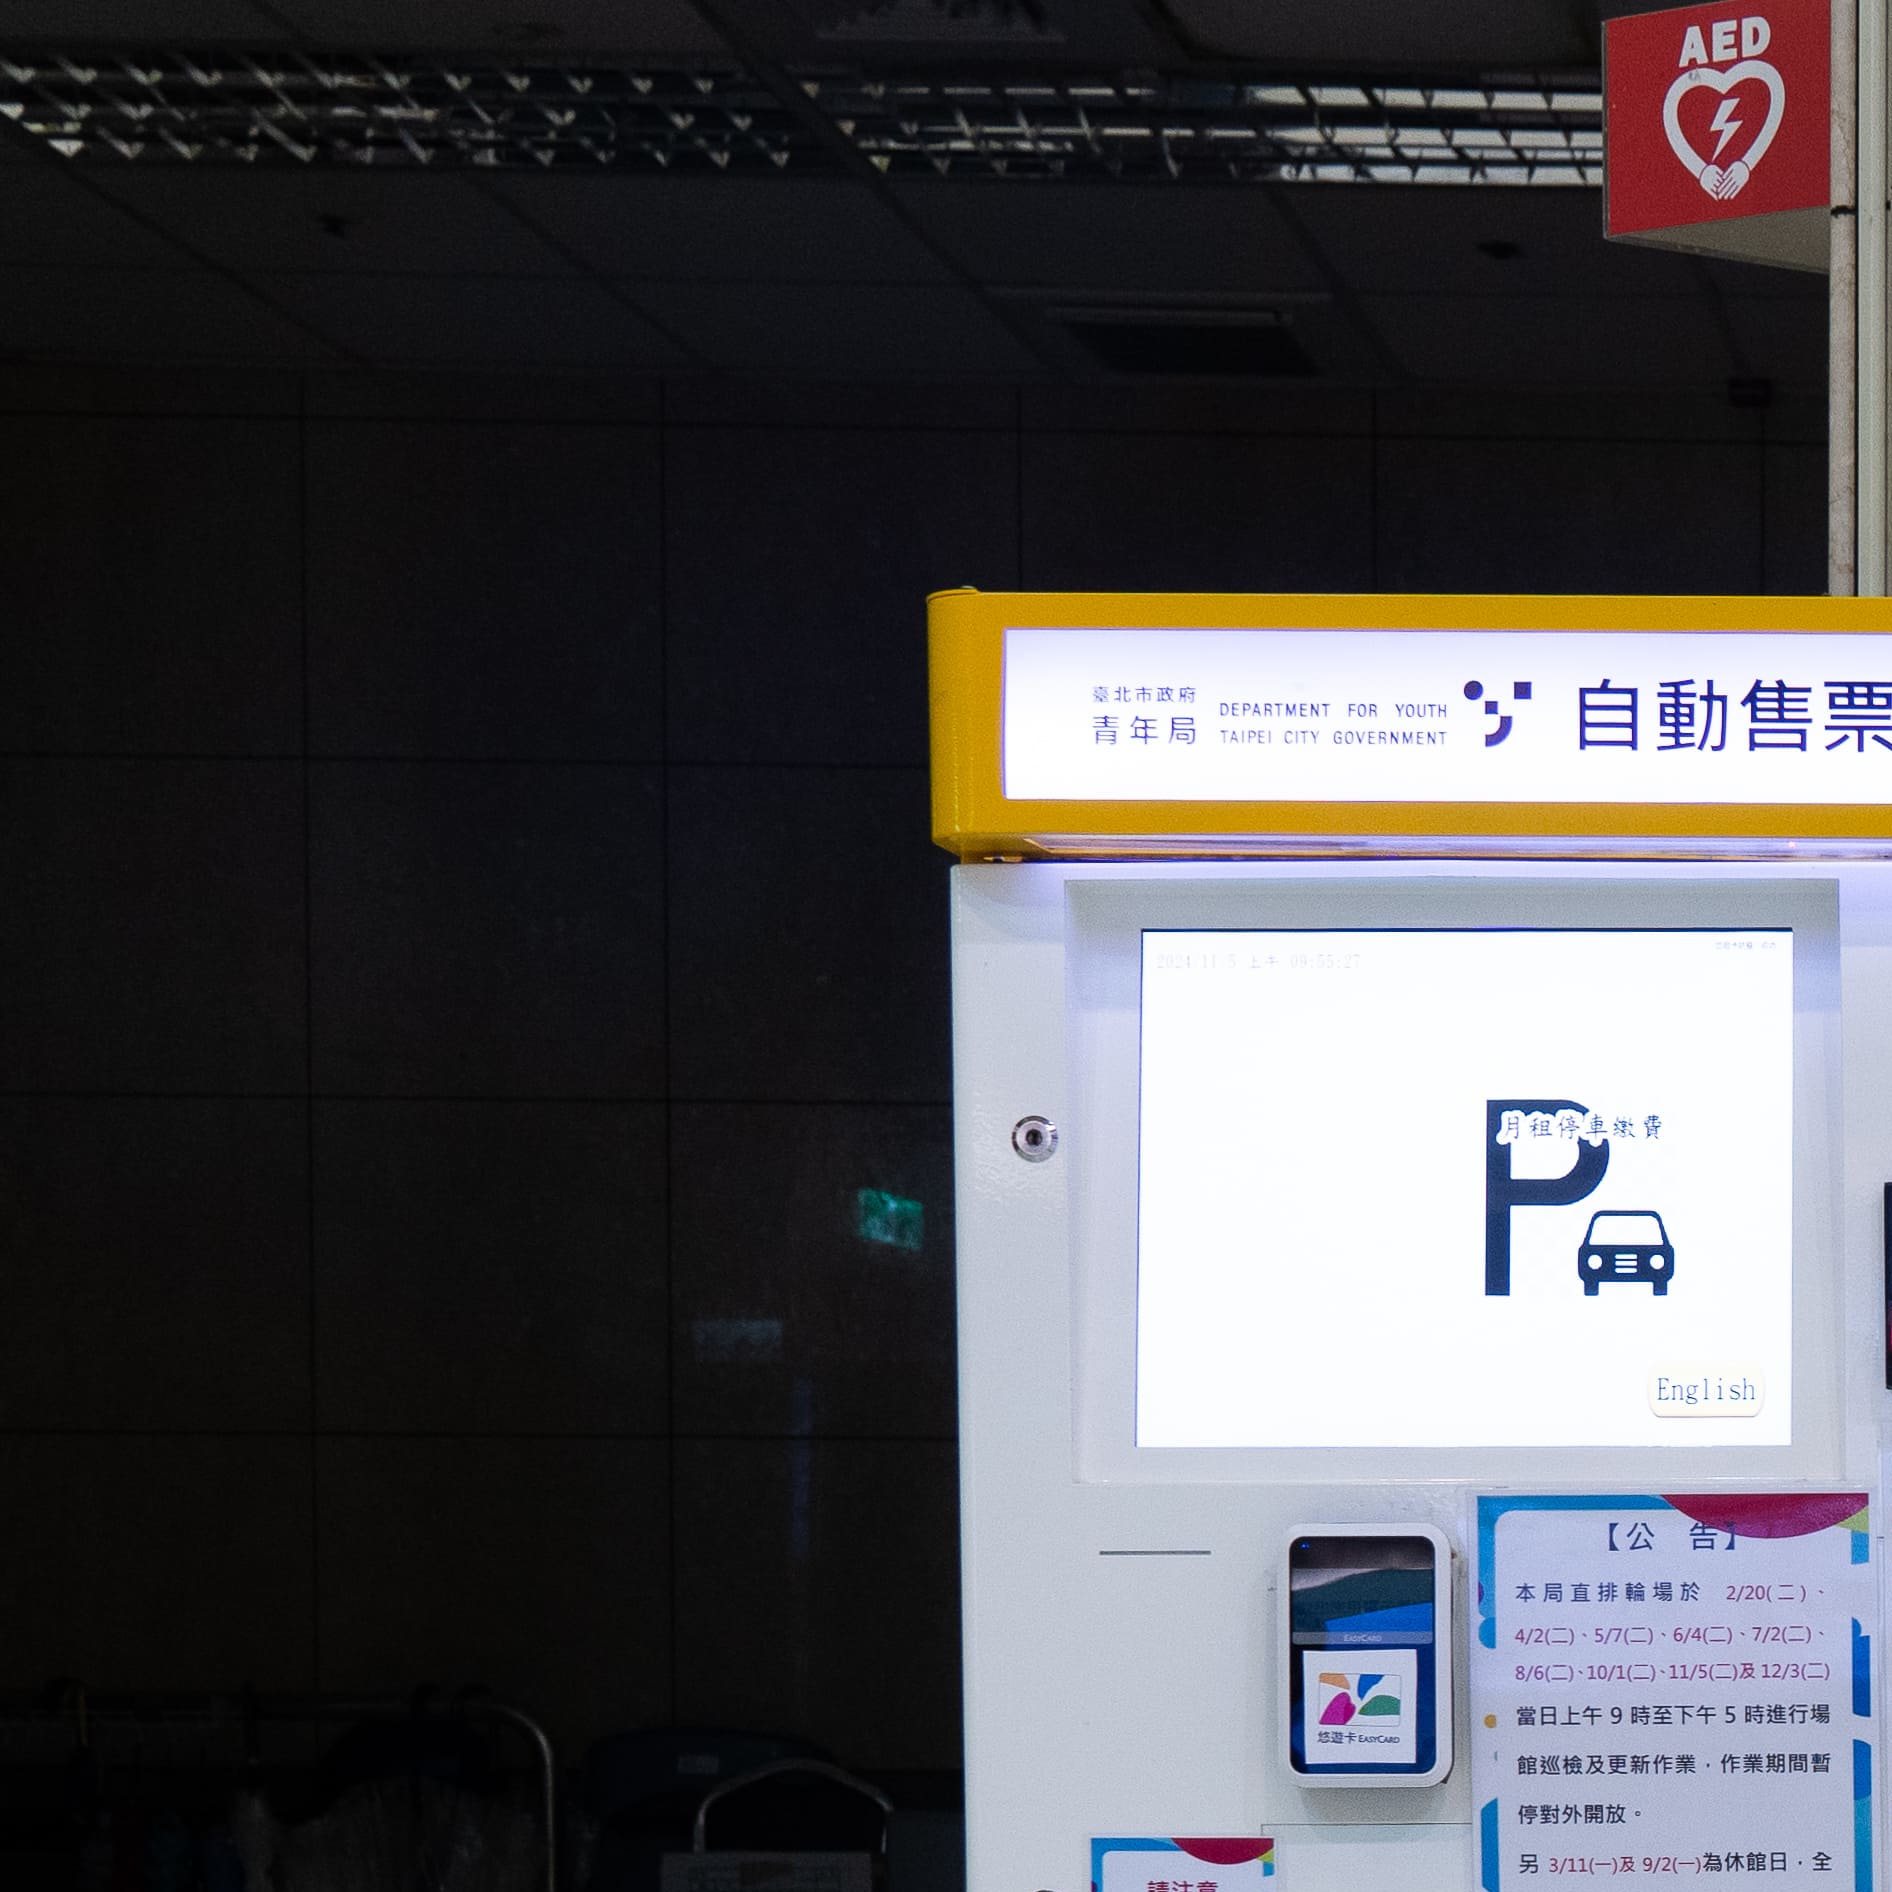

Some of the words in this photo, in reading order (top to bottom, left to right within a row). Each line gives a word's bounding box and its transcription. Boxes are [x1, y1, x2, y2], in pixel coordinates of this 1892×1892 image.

[1679, 17, 1770, 67] AED
[1094, 687, 1195, 702] 臺北市政府
[1220, 703, 1330, 717] DEPARTMENT
[1348, 704, 1377, 717] FOR
[1395, 704, 1446, 717] YOUTH
[1094, 715, 1195, 744] 青年局
[1220, 730, 1271, 744] TAIPEI
[1284, 730, 1319, 744] CITY
[1333, 731, 1446, 744] GOVERNMENT
[1503, 1114, 1663, 1140] 月租停車繳費
[1657, 1377, 1756, 1405] English
[1516, 1582, 1700, 1602] 本局直排輪場於
[1318, 1731, 1357, 1744] 悠遊卡
[1518, 1804, 1640, 1824] 停對外開放。
